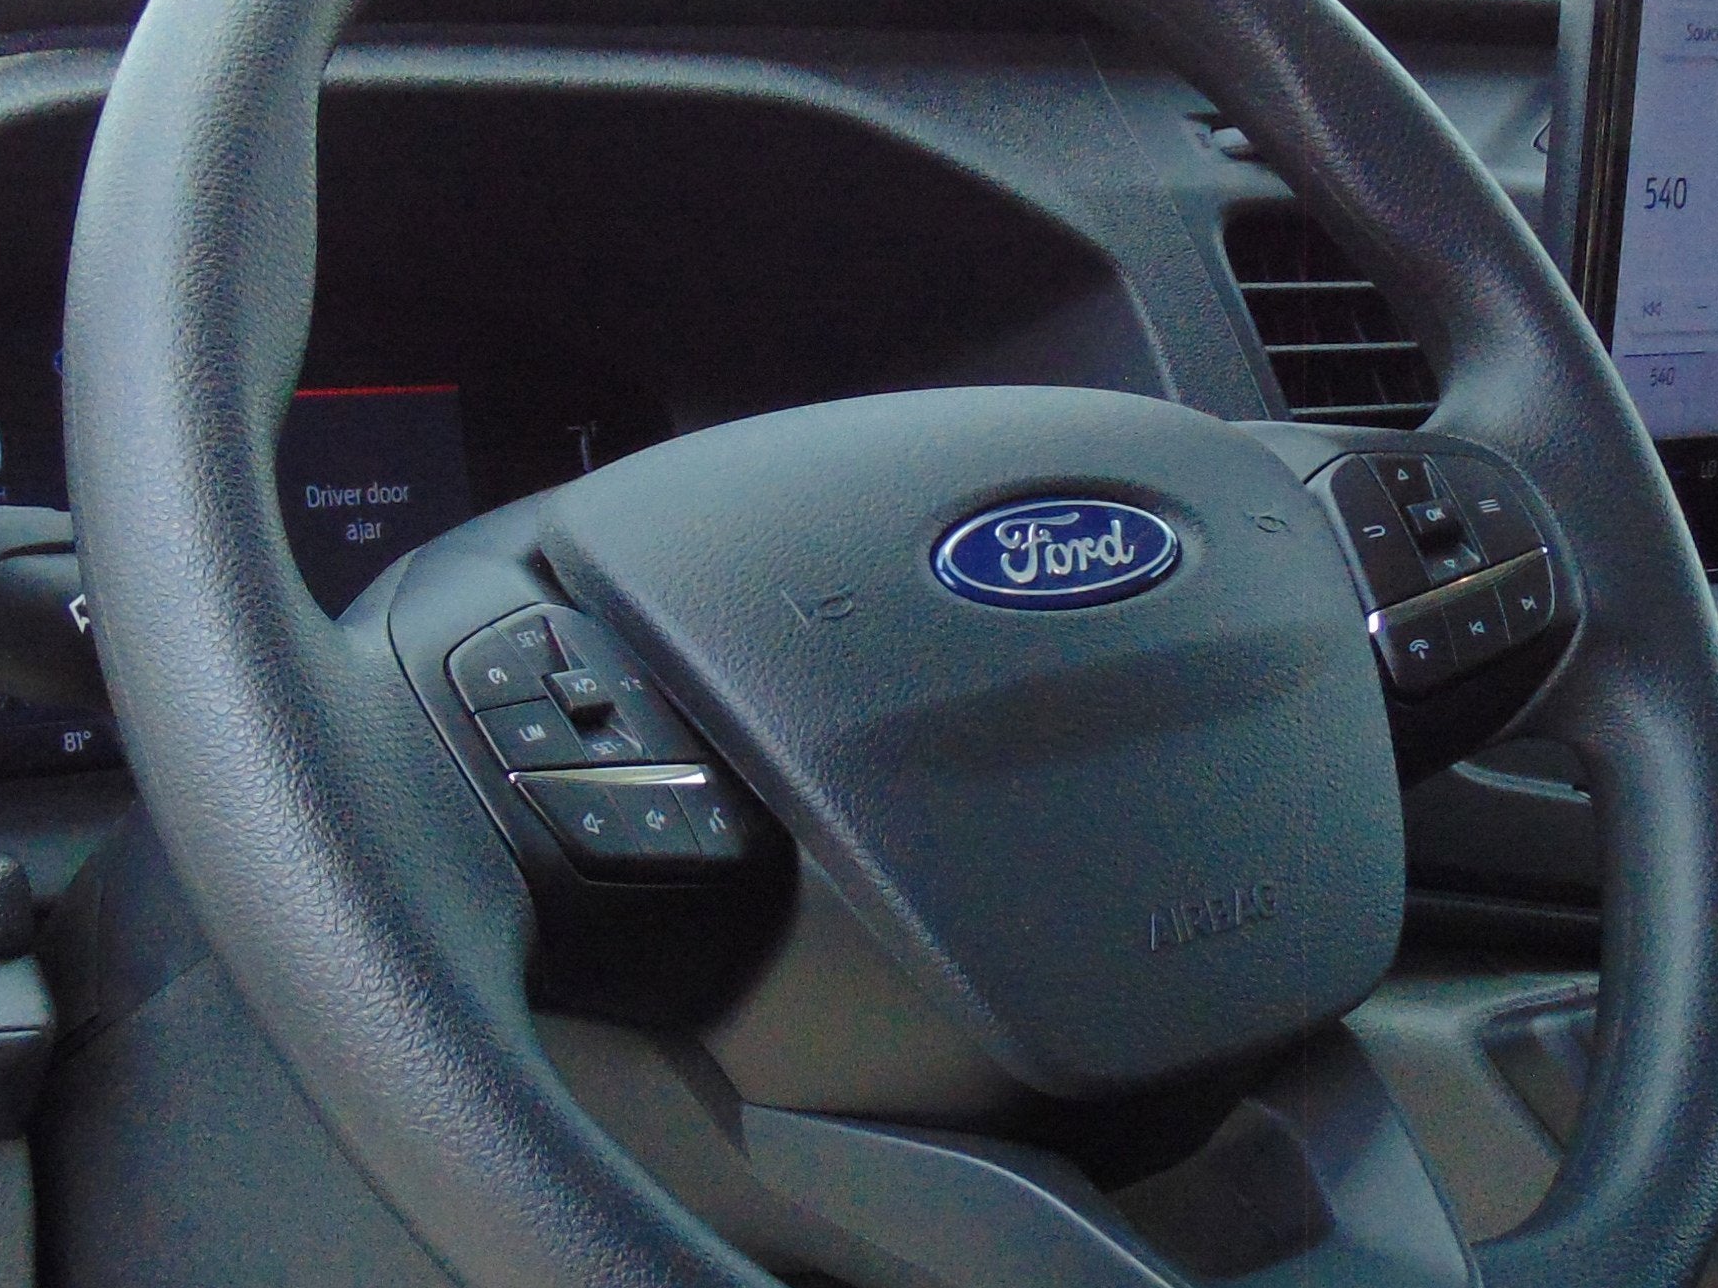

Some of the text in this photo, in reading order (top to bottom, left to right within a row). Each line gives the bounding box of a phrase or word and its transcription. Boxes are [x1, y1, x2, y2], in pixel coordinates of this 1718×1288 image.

[1643, 176, 1688, 210] 540
[1650, 367, 1675, 387] 540
[305, 480, 409, 508] Driver door
[345, 518, 382, 545] ajar
[994, 510, 1136, 584] Ford
